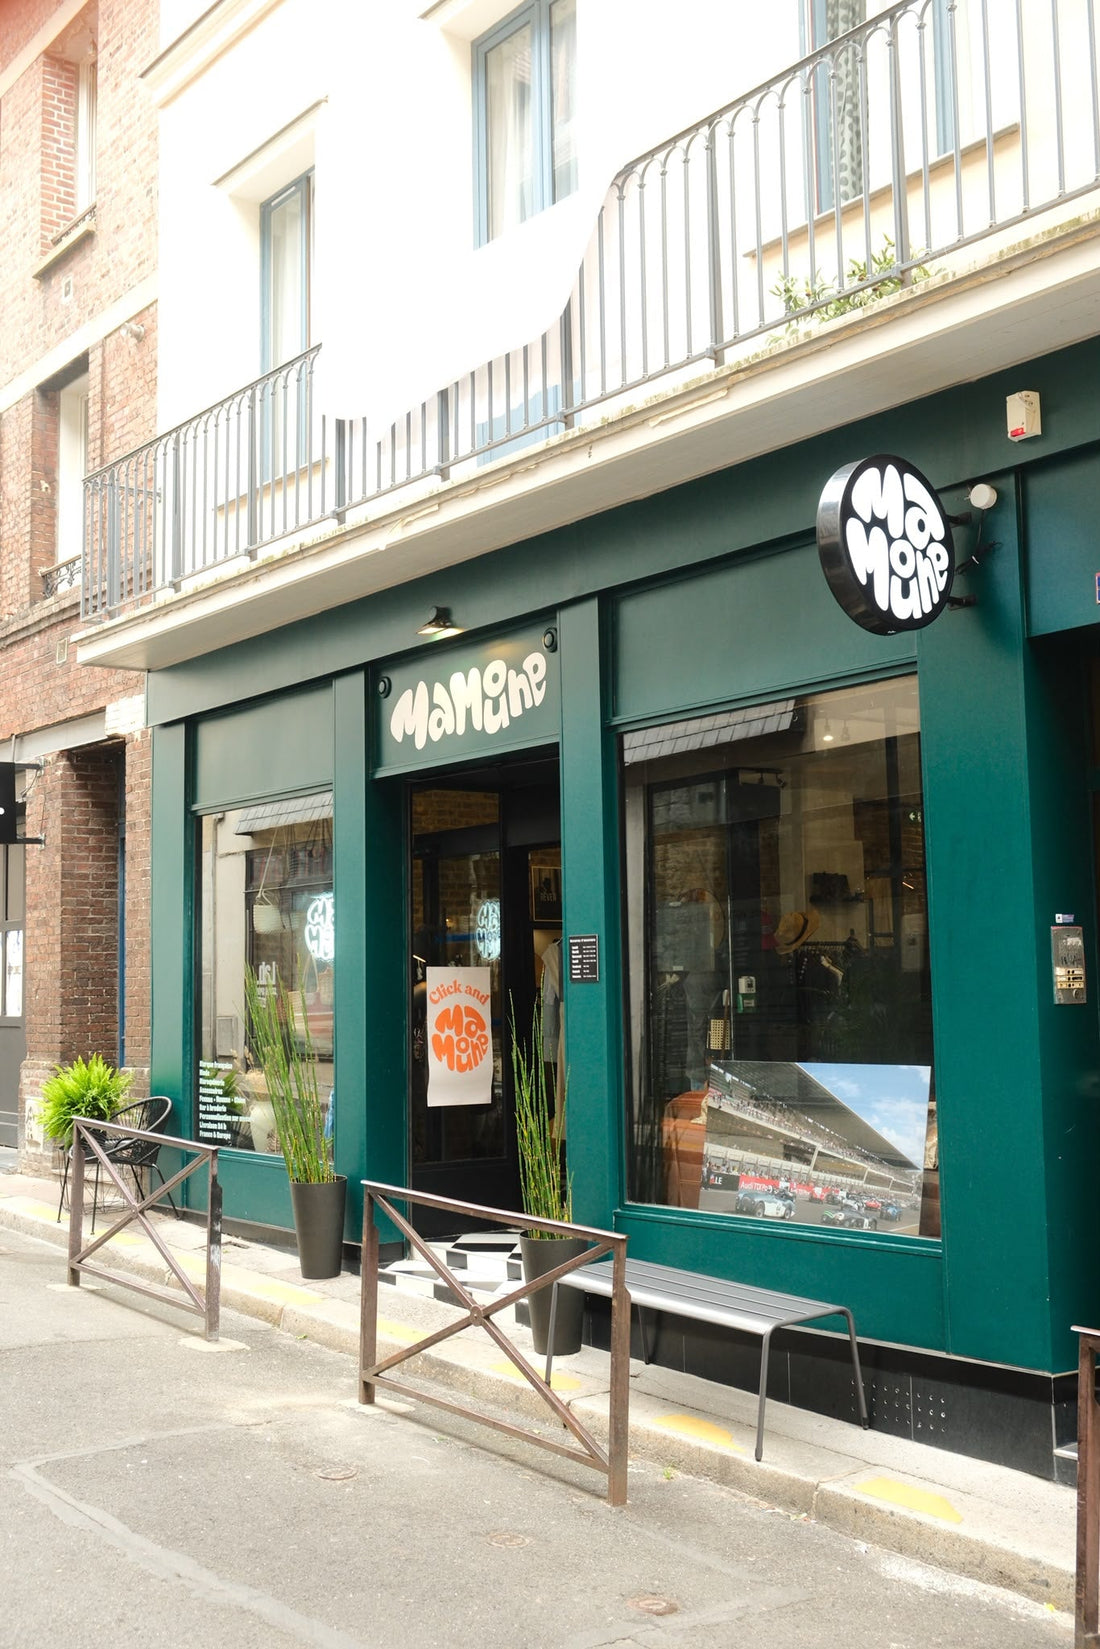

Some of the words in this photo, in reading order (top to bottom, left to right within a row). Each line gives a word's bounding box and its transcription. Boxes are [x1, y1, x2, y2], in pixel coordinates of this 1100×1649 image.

[851, 464, 945, 550] Ma
[846, 517, 949, 620] Moune
[429, 979, 462, 1005] Click
[465, 984, 490, 1006] and
[435, 1004, 487, 1039] Ma
[431, 1033, 489, 1073] Moune
